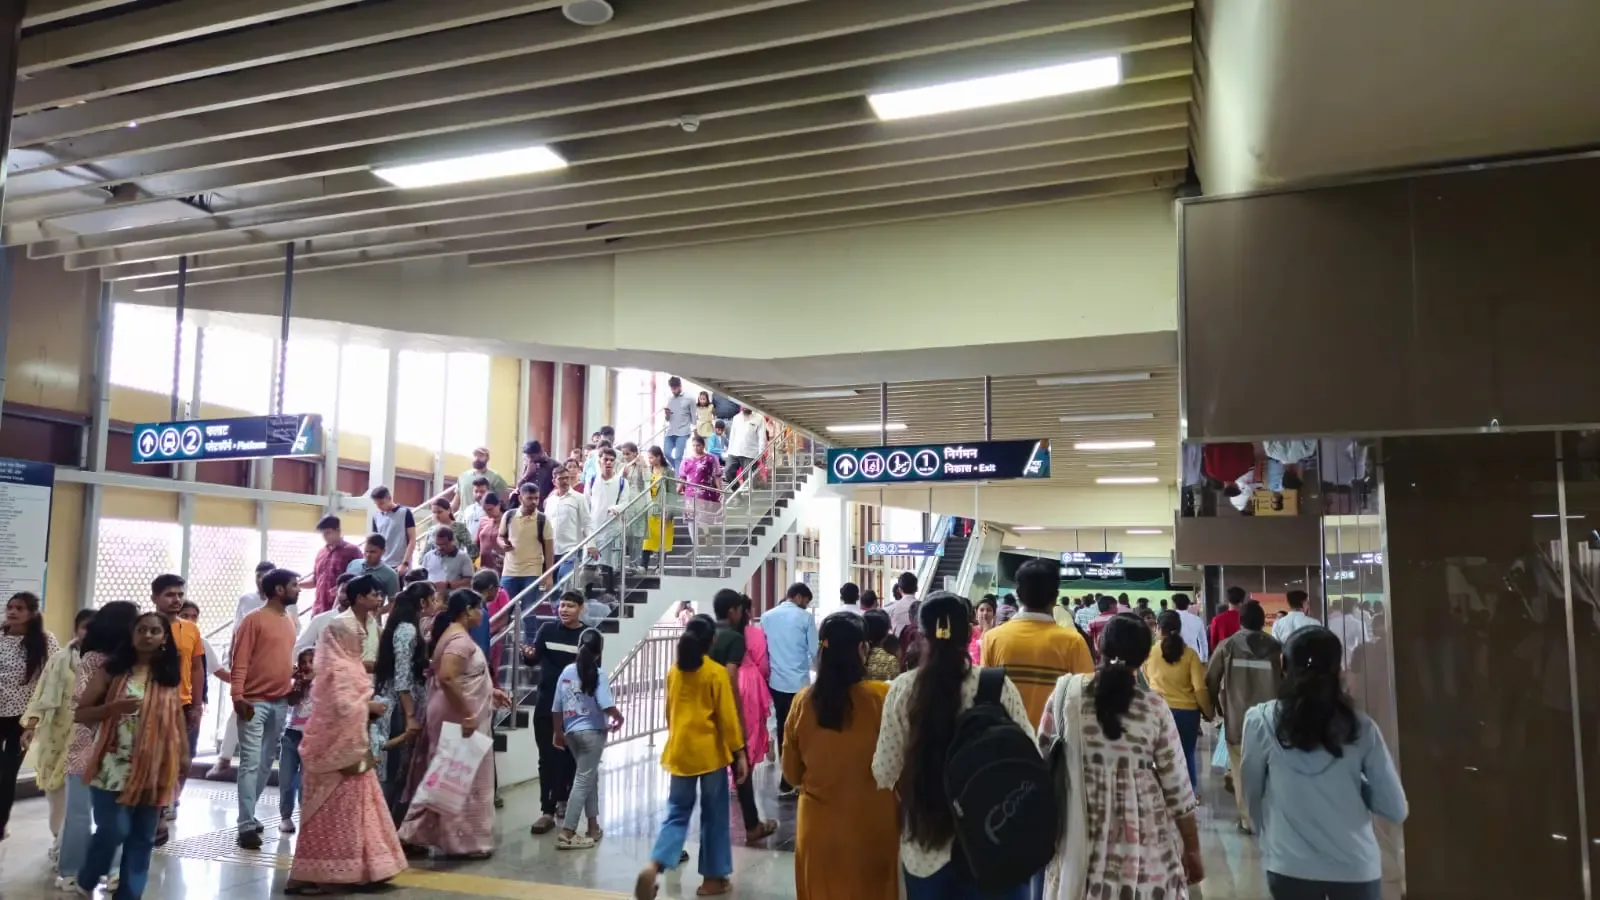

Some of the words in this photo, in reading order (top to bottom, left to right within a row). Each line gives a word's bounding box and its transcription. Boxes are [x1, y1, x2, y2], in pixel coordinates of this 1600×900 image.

[185, 429, 197, 449] 2
[943, 446, 978, 460] निर्गमन
[921, 454, 930, 467] 1
[944, 463, 972, 474] निकास
[979, 463, 997, 473] Exit
